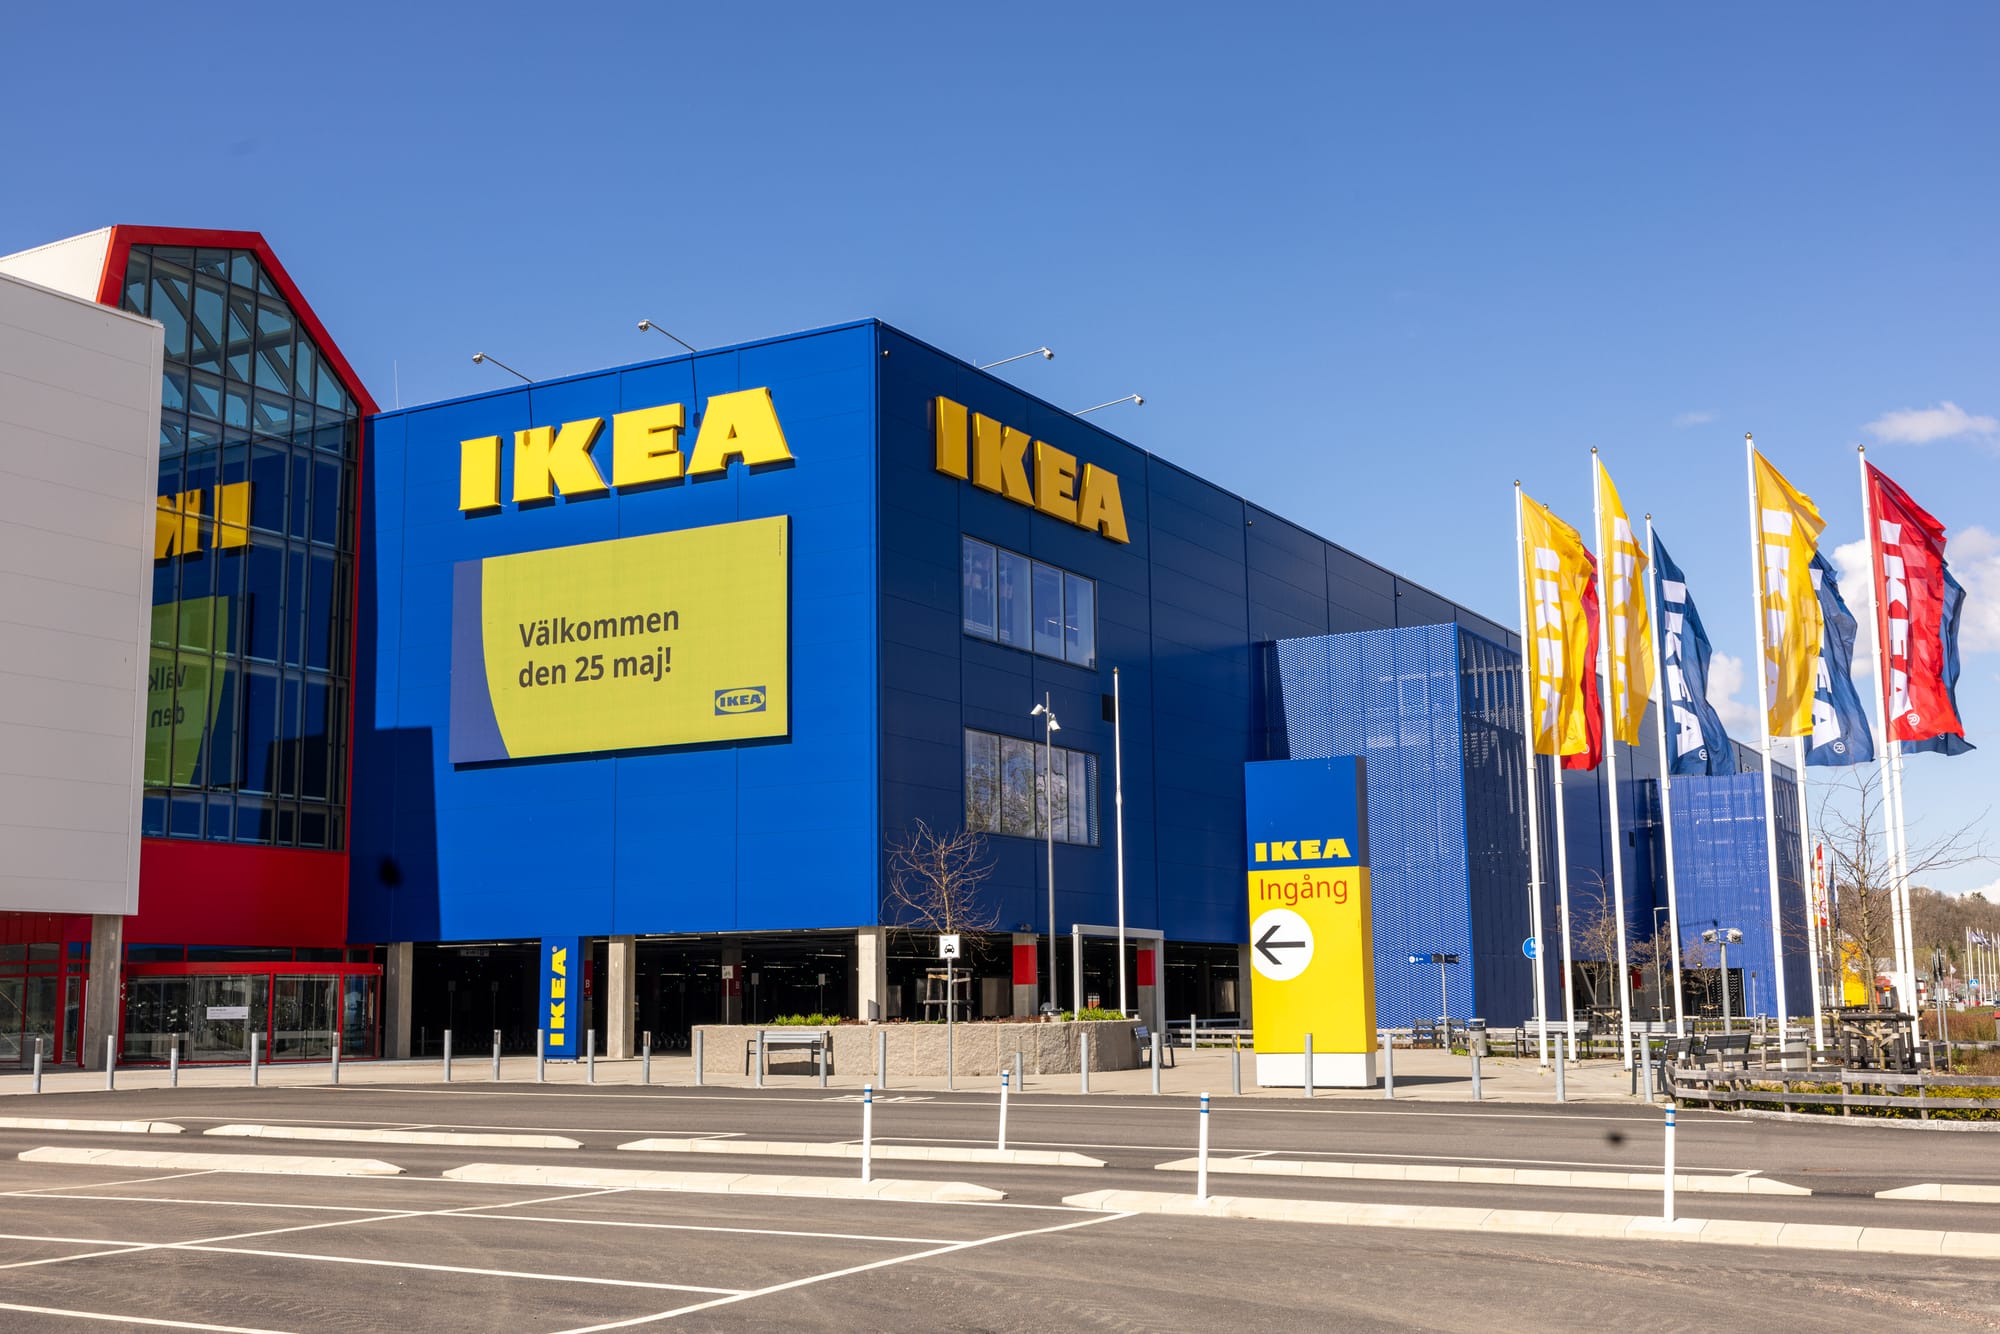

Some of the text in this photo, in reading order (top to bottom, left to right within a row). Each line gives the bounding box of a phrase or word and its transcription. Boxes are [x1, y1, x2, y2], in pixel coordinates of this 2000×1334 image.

[458, 386, 796, 511] IKEA
[935, 395, 1131, 544] IKEA
[519, 609, 679, 648] Välkommen
[1880, 519, 1914, 722] IKEA
[518, 646, 672, 688] den 25 maj!
[720, 694, 762, 707] IKEA
[1661, 579, 1705, 758] IKEA
[1255, 838, 1351, 862] IKEA
[1260, 874, 1348, 906] Ingång
[550, 947, 567, 1046] IKEA
